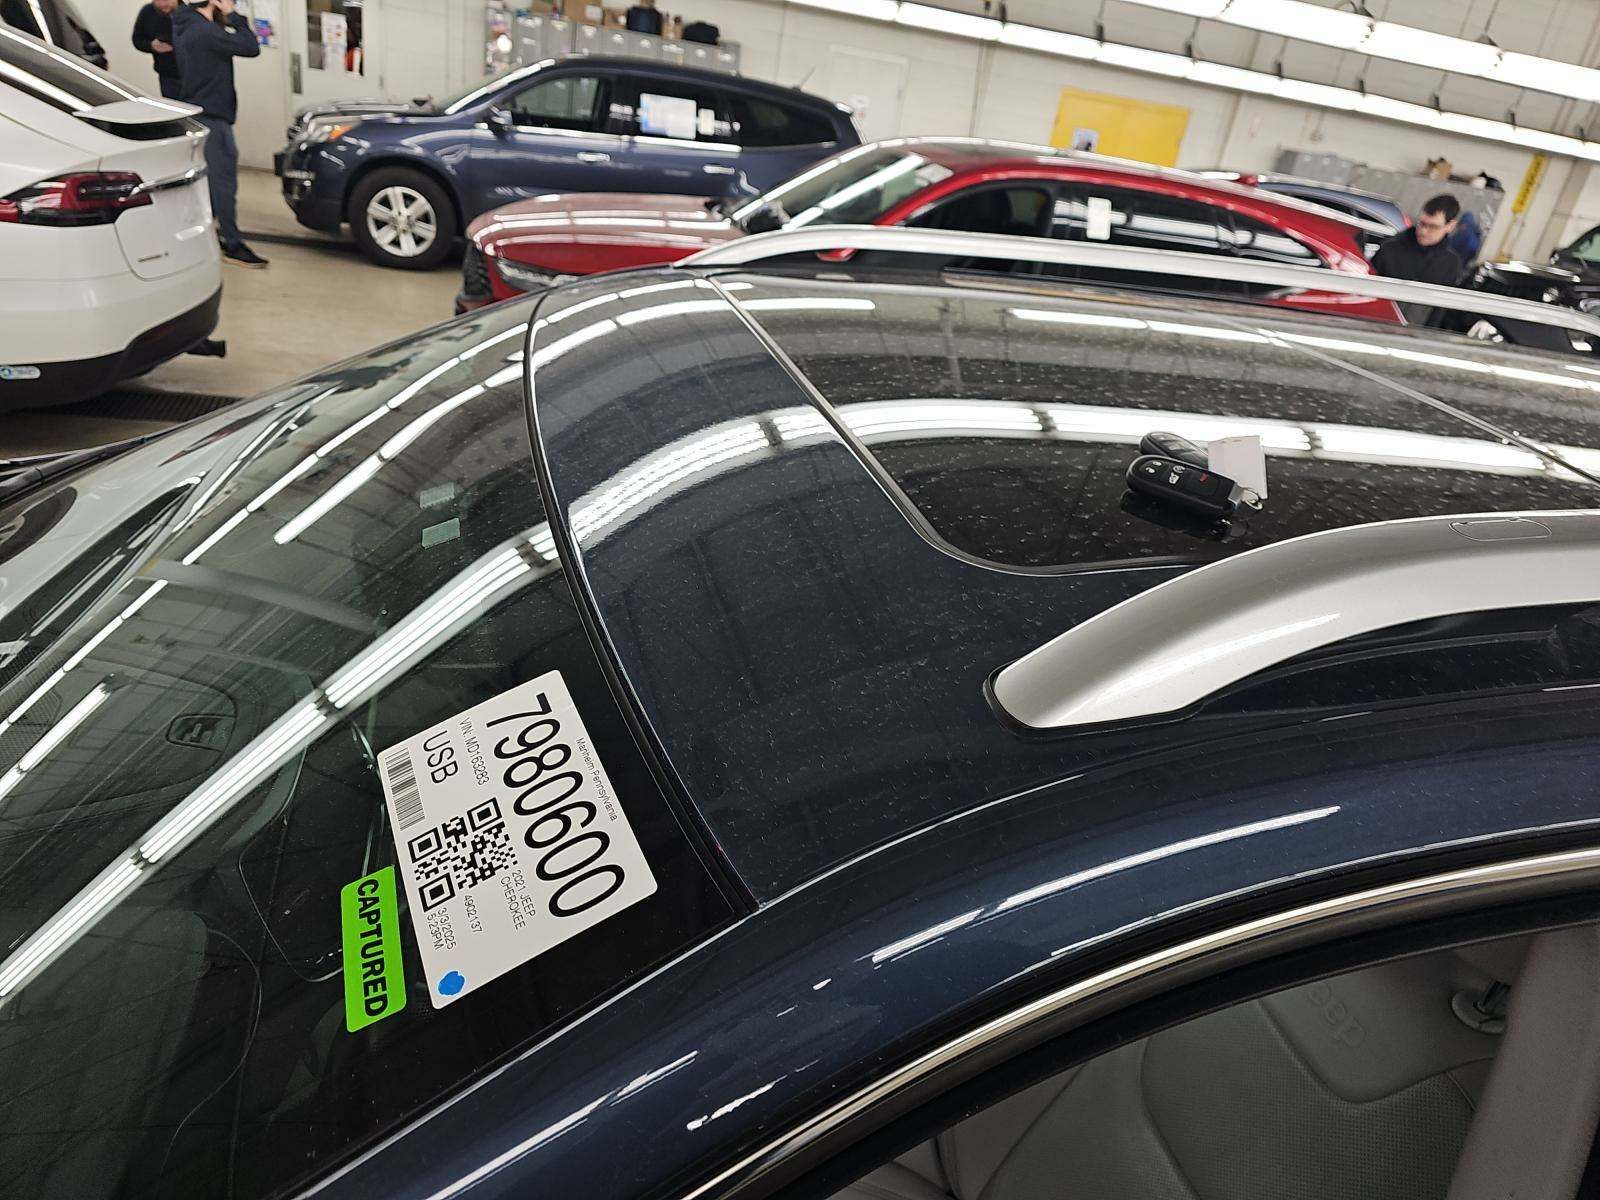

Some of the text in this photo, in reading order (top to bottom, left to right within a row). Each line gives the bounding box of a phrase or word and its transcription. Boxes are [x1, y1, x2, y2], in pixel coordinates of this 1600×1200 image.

[423, 730, 458, 783] USB
[460, 718, 489, 785] VIN: MD163283
[486, 692, 625, 917] 7980600
[577, 738, 617, 821] Manheim Pennsylvania
[464, 896, 482, 932] 4902137
[501, 877, 525, 929] CHEROKEE
[512, 870, 535, 916] 2021 JEEP
[355, 878, 388, 1017] CAPTURED
[427, 913, 444, 950] 5:23PM
[437, 908, 456, 949] 3/3/2025
[1304, 983, 1368, 1048] eep
